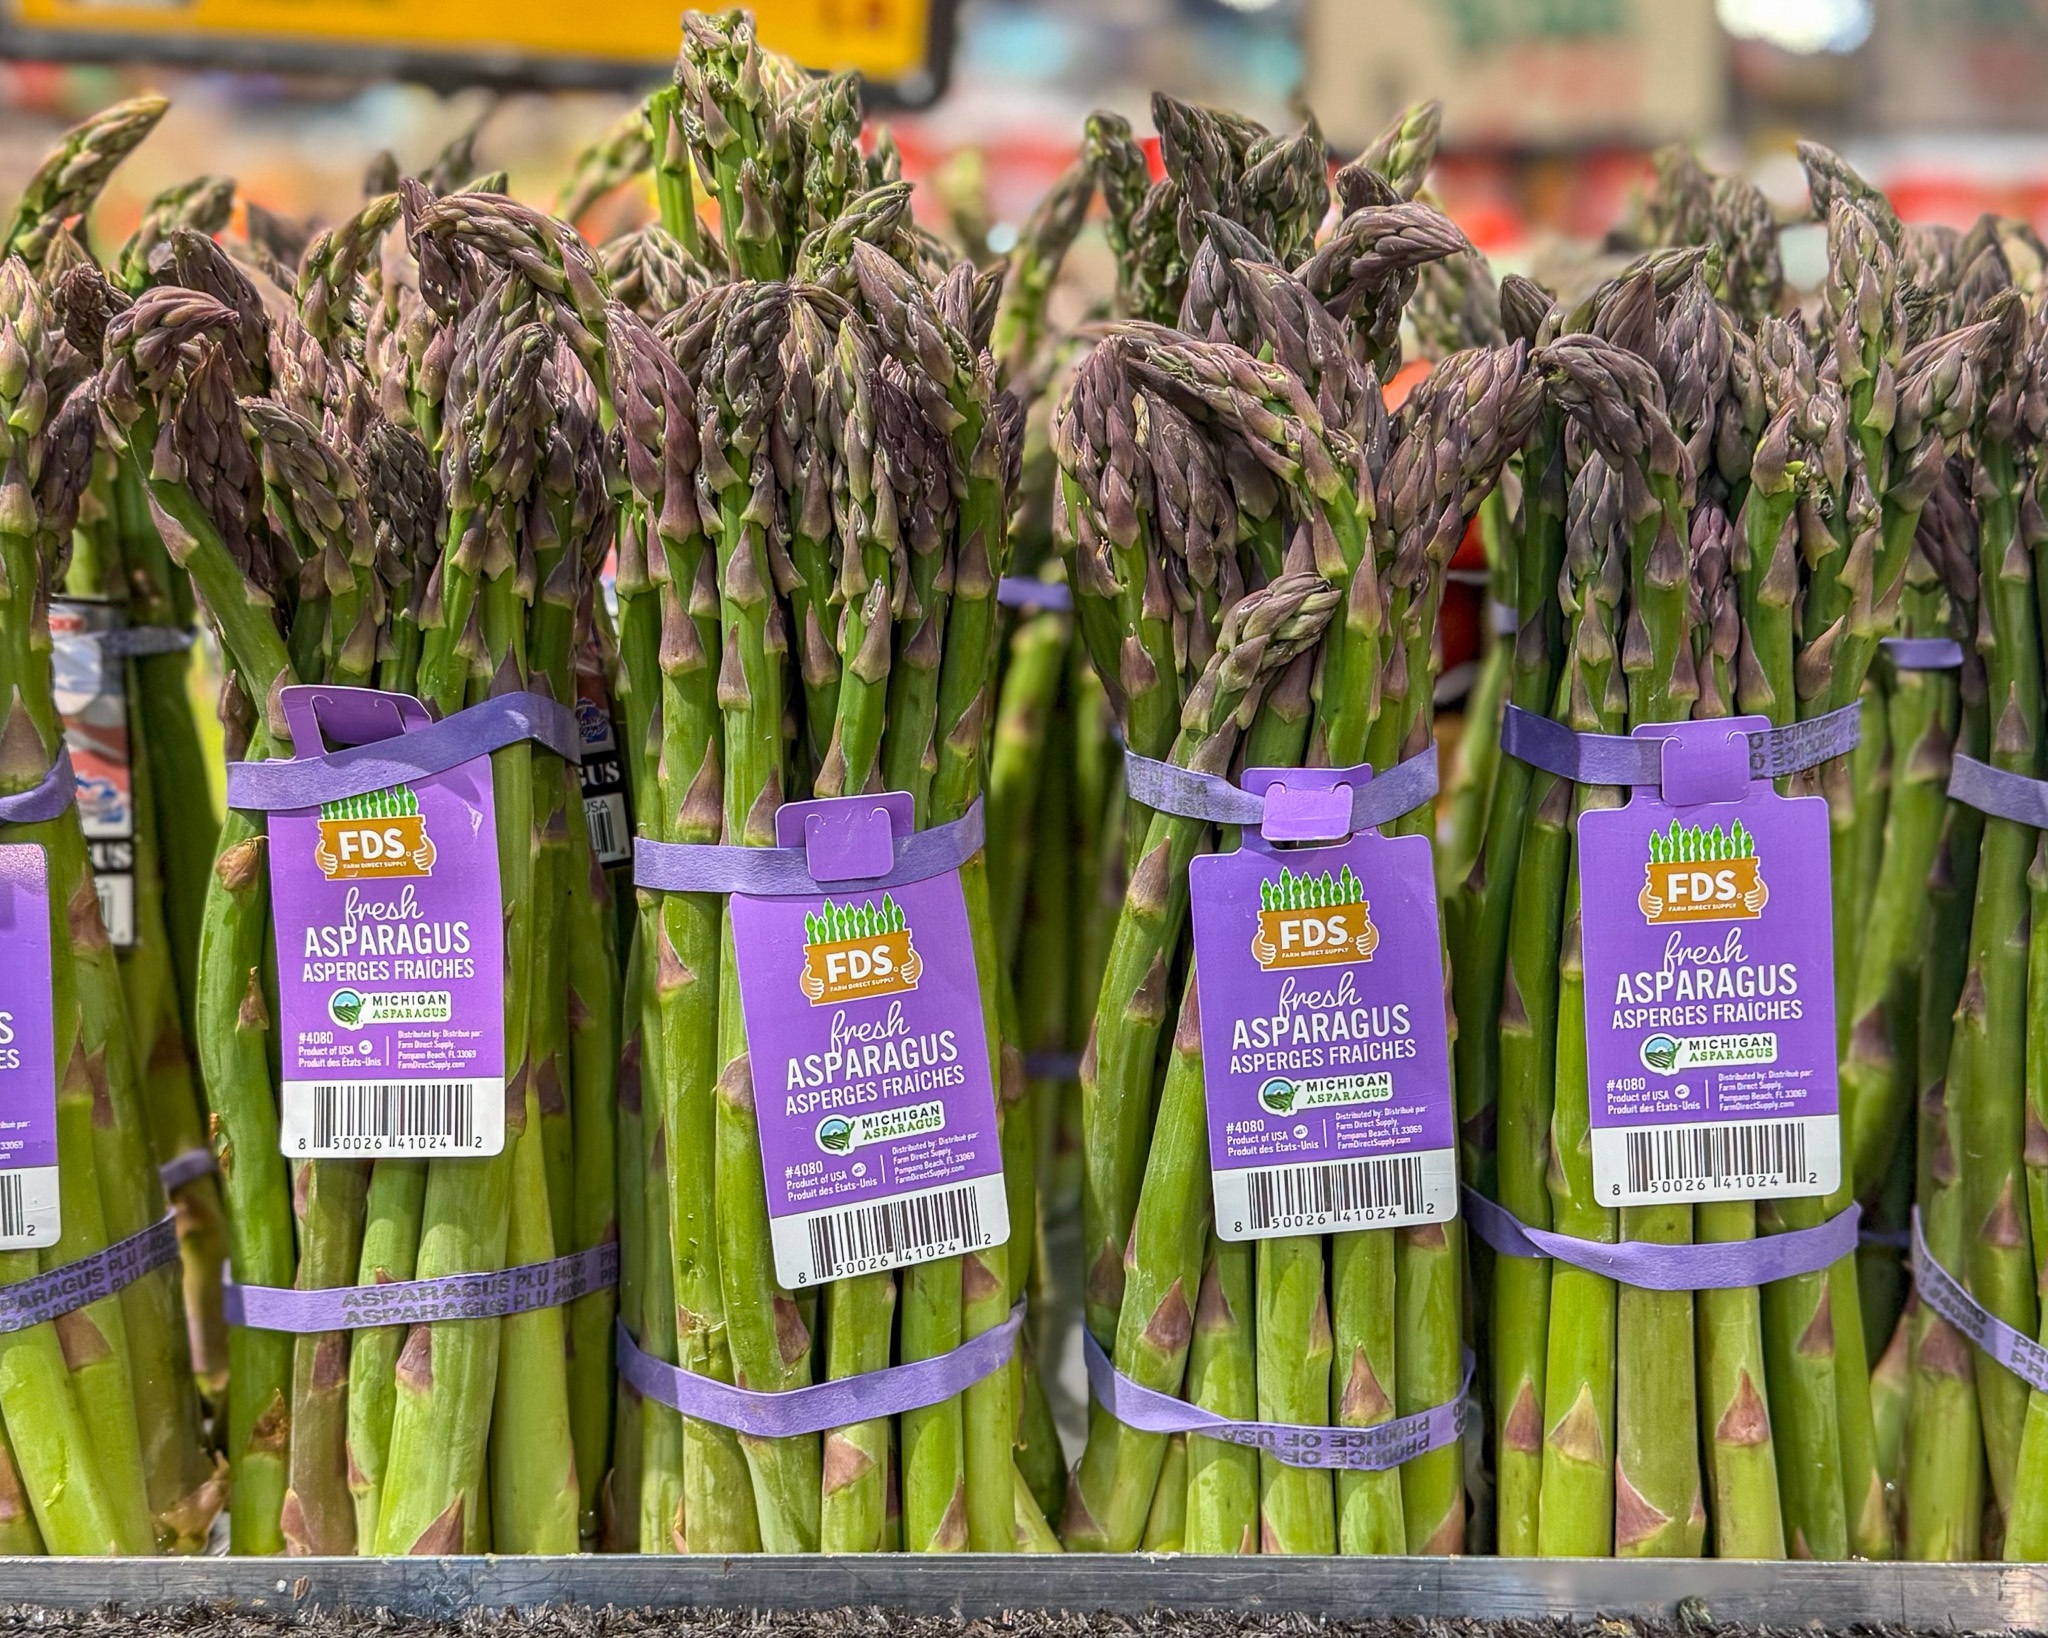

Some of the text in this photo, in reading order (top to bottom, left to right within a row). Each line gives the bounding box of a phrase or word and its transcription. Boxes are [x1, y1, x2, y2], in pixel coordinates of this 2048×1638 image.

[345, 884, 424, 930] fresh
[305, 922, 470, 957] ASPARAGUS
[1664, 927, 1749, 976] fresh
[303, 956, 474, 982] ASPERGES FRAÎCHES
[848, 980, 870, 989] DIRECT
[872, 977, 894, 985] SUPPLY
[1615, 963, 1797, 1005] ASPARAGUS
[372, 994, 446, 1006] MICHIGAN
[1279, 971, 1362, 1022] fresh
[372, 1008, 447, 1019] ASPARAGUS
[1612, 998, 1802, 1030] ASPERGES FRAÎCHES
[830, 1000, 910, 1057] fresh
[1232, 1004, 1411, 1050] ASPARAGUS
[299, 1031, 333, 1044] #4080
[1689, 1036, 1772, 1050] MICHIGAN
[299, 1046, 327, 1055] Product
[329, 1045, 337, 1055] of
[339, 1045, 354, 1055] USA
[1230, 1038, 1416, 1074] ASPERGES FRAÎCHES
[1689, 1047, 1773, 1062] ASPARAGUS
[299, 1058, 325, 1067] Produit
[327, 1058, 340, 1066] des
[786, 1030, 958, 1091] ASPARAGUS
[786, 1065, 965, 1116] ASPERGES FRAÎCHES
[1307, 1074, 1388, 1092] MICHIGAN
[1607, 1077, 1645, 1092] #4080
[1307, 1087, 1389, 1105] ASPARAGUS
[1608, 1093, 1640, 1103] Product
[1642, 1091, 1650, 1101] of
[1652, 1090, 1670, 1100] USA
[862, 1105, 940, 1129] MICHIGAN
[1608, 1104, 1637, 1114] Produit
[1640, 1103, 1654, 1112] des
[863, 1116, 941, 1140] ASPARAGUS
[1226, 1119, 1264, 1134] #4080
[1354, 1121, 1374, 1129] Direct
[299, 1137, 482, 1149] 8 50026 41024 2
[1227, 1135, 1259, 1145] Product
[1261, 1133, 1269, 1142] of
[1271, 1131, 1288, 1141] USA
[910, 1152, 929, 1161] Direct
[1228, 1146, 1257, 1157] Produit
[1259, 1145, 1273, 1154] des
[785, 1161, 823, 1179] #4080
[787, 1171, 847, 1190] Product of USA
[1612, 1172, 1817, 1196] 8 50026 41024 2
[788, 1189, 817, 1201] Produit
[819, 1187, 834, 1196] des
[1234, 1204, 1434, 1233] 8 50026 41024 2
[27, 1225, 36, 1236] 2
[798, 1233, 991, 1284] 8 50026 41024 2
[342, 1277, 510, 1308] ASPARAGUS
[515, 1269, 549, 1291] PLU
[344, 1297, 508, 1326] ASPARAGUS
[514, 1289, 548, 1310] PLU
[1285, 1431, 1322, 1448] OF
